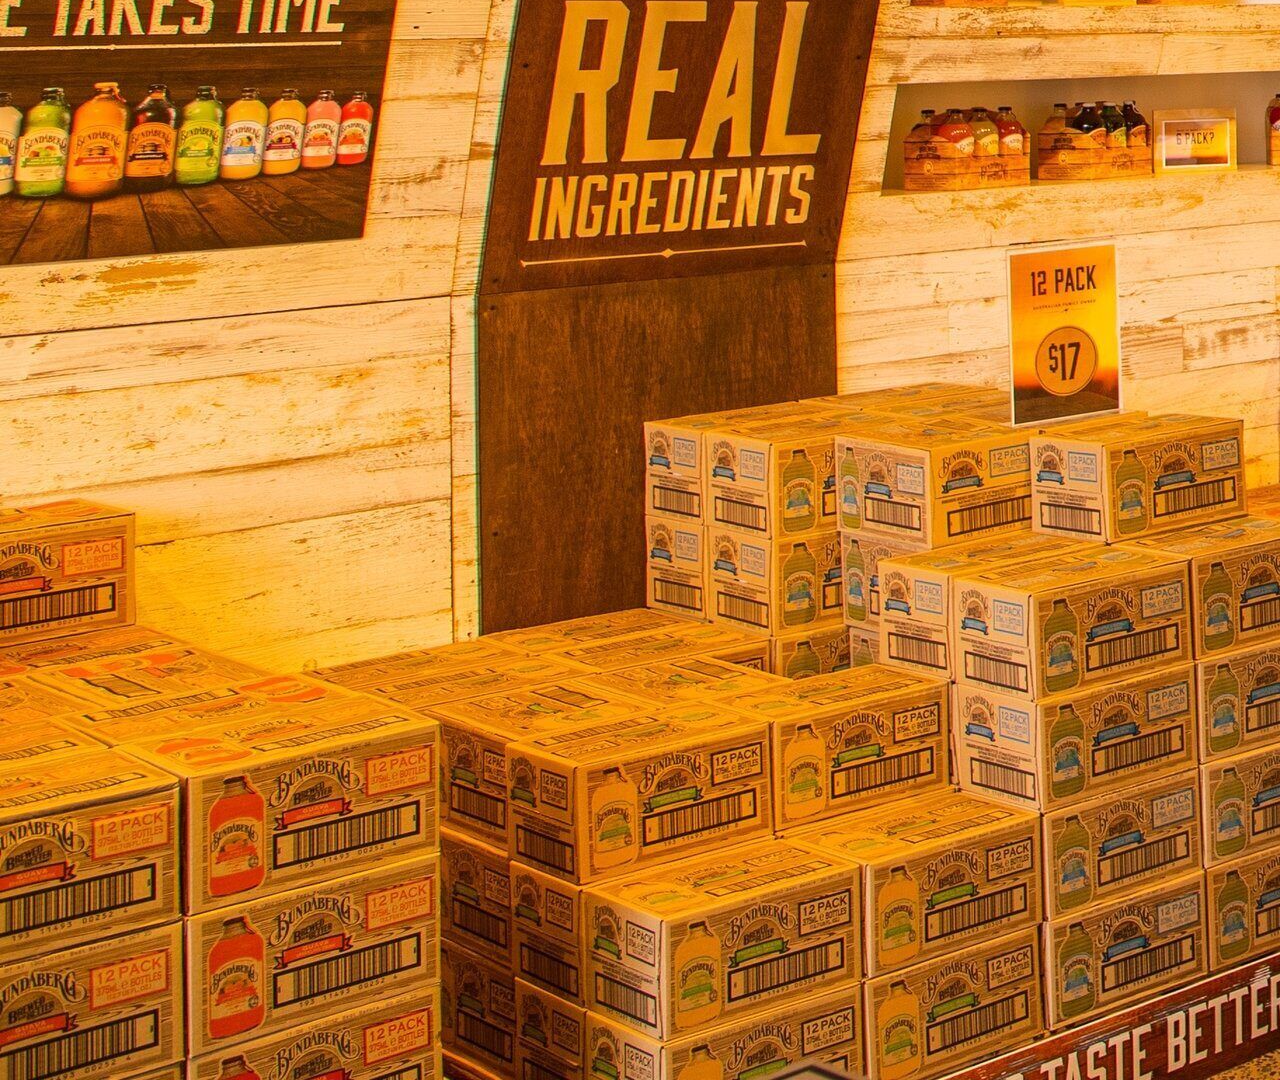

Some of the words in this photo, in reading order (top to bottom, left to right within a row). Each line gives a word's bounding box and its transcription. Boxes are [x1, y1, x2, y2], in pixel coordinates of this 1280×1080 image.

[540, 0, 822, 167] REAL
[1176, 133, 1182, 145] 6
[1185, 129, 1215, 144] PACK?
[527, 165, 816, 242] INGREDIENTS
[1031, 270, 1047, 296] 12
[1054, 265, 1096, 294] PACK
[1048, 341, 1081, 381] $17
[1004, 446, 1028, 459] PACK
[69, 547, 81, 557] 12
[85, 542, 119, 556] PACK
[1145, 590, 1154, 601] 12
[1155, 585, 1180, 599] PACK
[897, 714, 909, 724] 12
[910, 708, 936, 721] PACK
[372, 761, 388, 773] 12
[390, 753, 427, 770] PACK
[715, 756, 728, 767] 12
[730, 747, 759, 763] PACK
[268, 760, 360, 807] BUNDABERG
[99, 823, 117, 836] 12
[120, 810, 164, 831] PACK
[991, 852, 1002, 862] 12
[1003, 842, 1029, 858] PACK
[371, 896, 388, 908] 12
[389, 885, 427, 903] PACK
[803, 904, 815, 916] 12
[817, 895, 847, 912] PACK
[268, 894, 360, 946] BUNDABERG
[98, 971, 115, 984] 12
[119, 957, 161, 978] PACK
[991, 960, 1002, 970] 12
[1004, 950, 1029, 966] PACK
[369, 1028, 385, 1040] 12
[388, 1016, 425, 1036] PACK
[806, 1024, 819, 1036] 12
[821, 1013, 850, 1031] PACK
[268, 1029, 360, 1080] BUNDABERG
